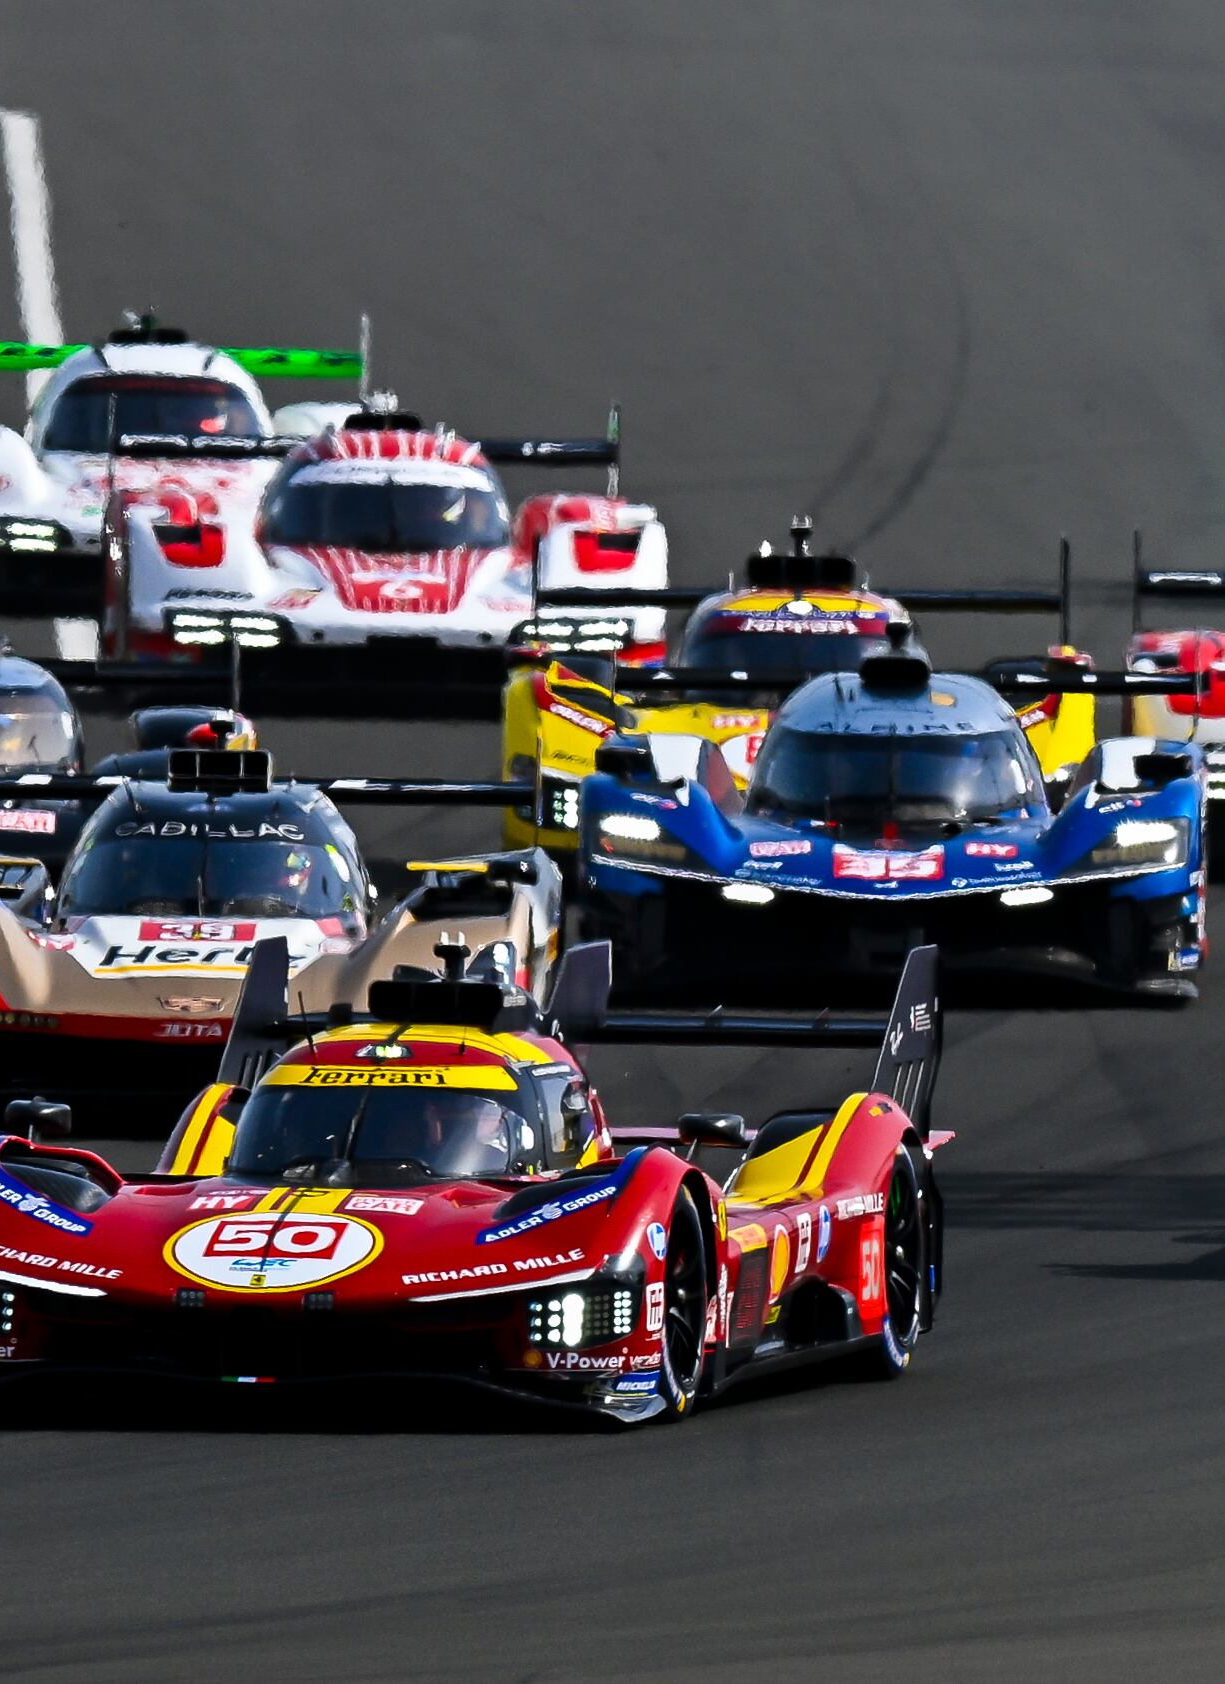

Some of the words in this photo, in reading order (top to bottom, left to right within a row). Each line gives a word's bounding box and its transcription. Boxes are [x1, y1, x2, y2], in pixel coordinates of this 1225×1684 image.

[115, 821, 304, 841] CADILLAC
[161, 922, 235, 941] 39
[99, 945, 307, 969] Hert
[299, 1066, 449, 1085] Ferrari
[189, 1195, 251, 1209] HY
[33, 1208, 87, 1232] GROUP
[485, 1216, 543, 1243] ADLER
[561, 1186, 617, 1212] GROUP
[212, 1223, 337, 1253] 50
[57, 1260, 123, 1280] MILLE
[402, 1263, 507, 1285] RICHARD
[513, 1248, 585, 1271] MILLE
[546, 1352, 625, 1369] V-Power
